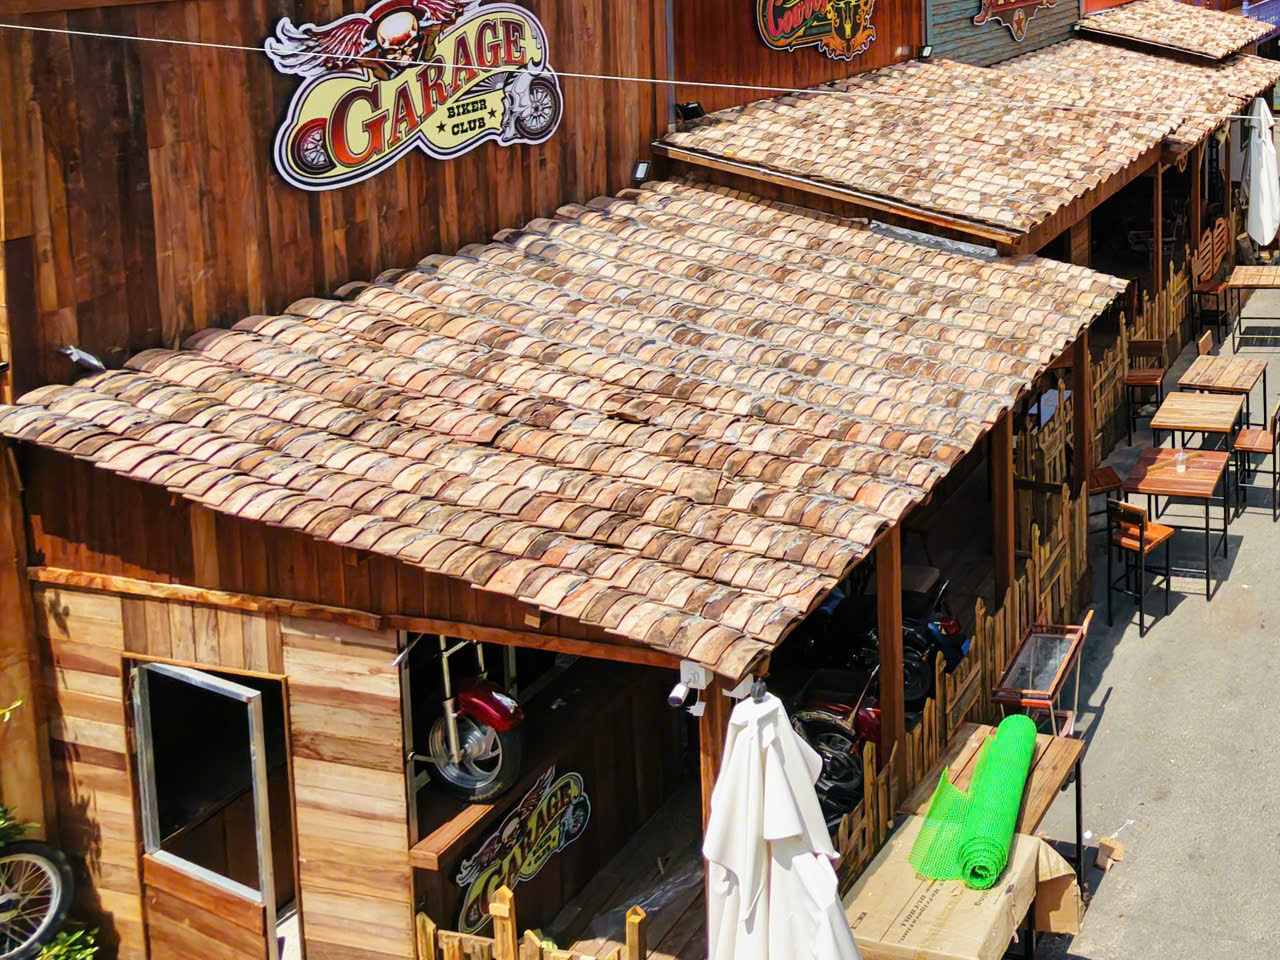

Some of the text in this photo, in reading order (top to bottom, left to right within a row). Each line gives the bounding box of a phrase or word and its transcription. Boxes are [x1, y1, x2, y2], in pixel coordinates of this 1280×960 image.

[329, 18, 528, 169] GARAGE
[446, 98, 488, 120] BIKER
[451, 116, 487, 137] CLUB
